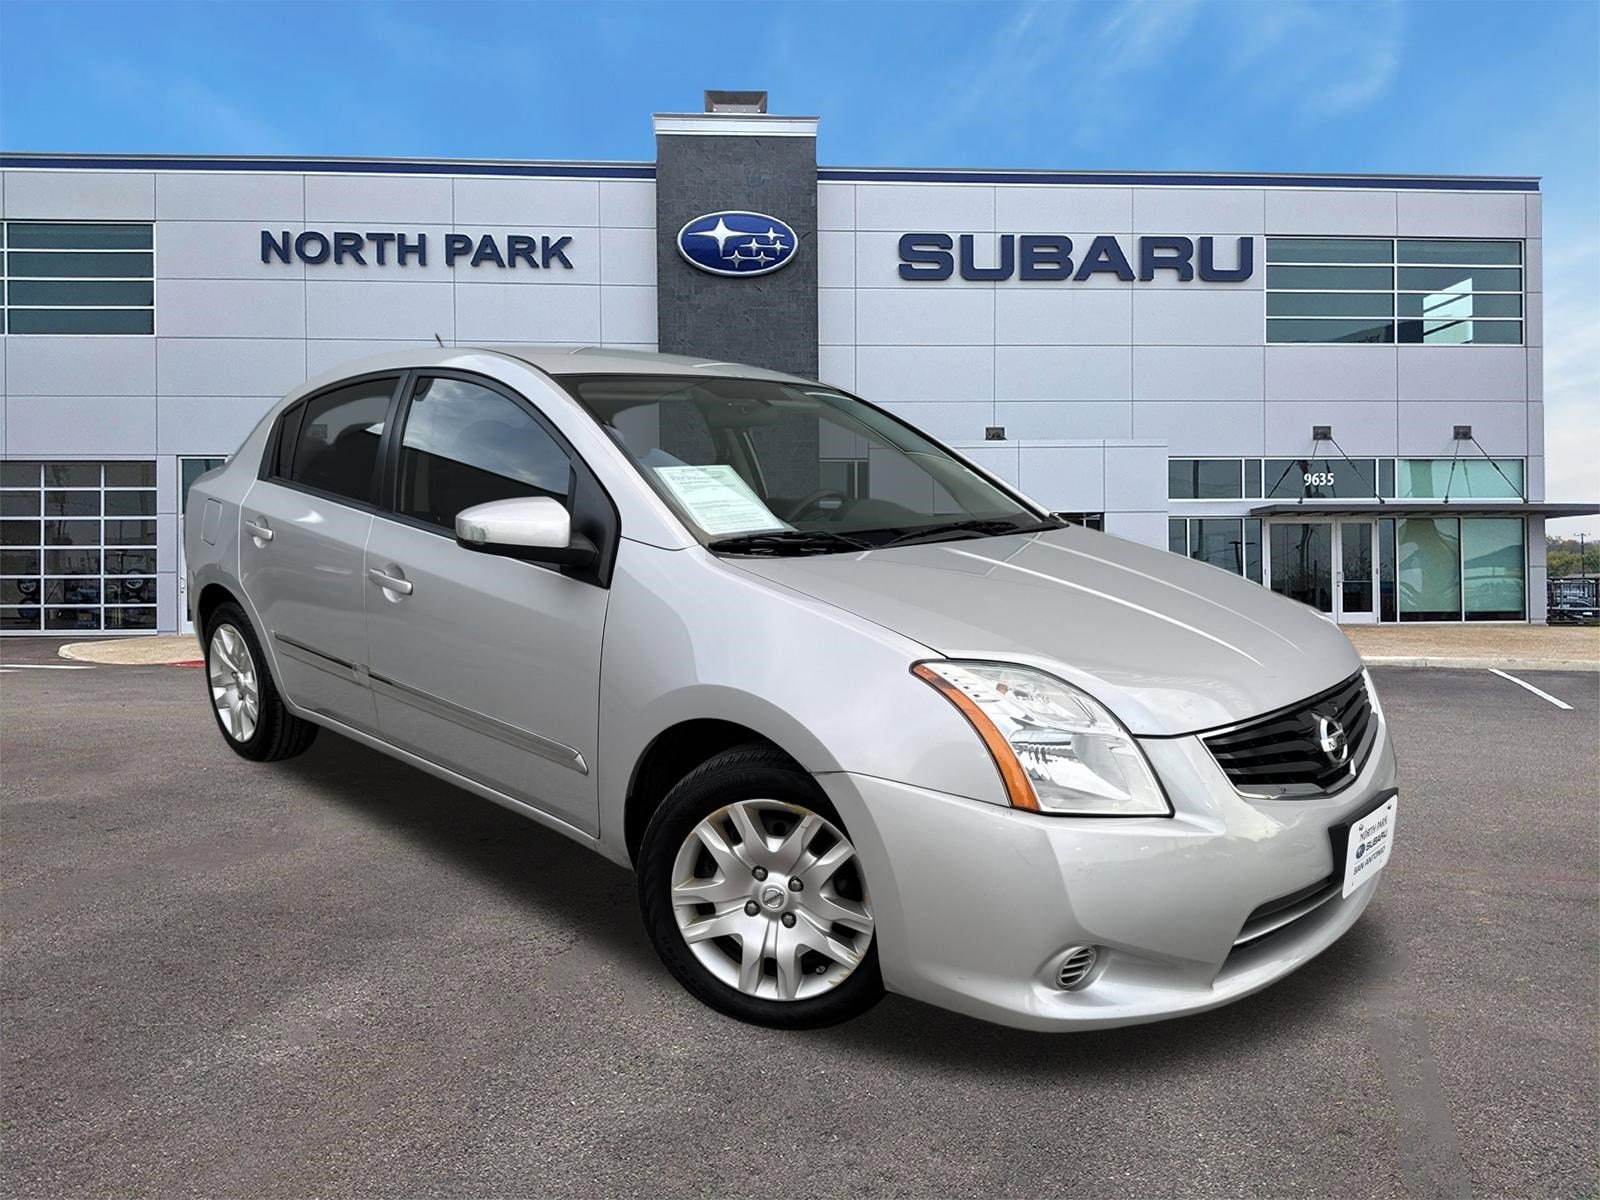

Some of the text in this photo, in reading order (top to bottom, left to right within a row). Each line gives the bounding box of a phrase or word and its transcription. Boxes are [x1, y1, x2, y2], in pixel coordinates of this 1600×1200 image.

[261, 231, 574, 270] NORTH PARK
[898, 233, 1254, 283] SUBARU
[1303, 472, 1335, 487] 9635
[1360, 824, 1376, 841] NORTH
[1365, 828, 1388, 851] SUBARU
[1353, 845, 1386, 875] SAN ANTONIO
